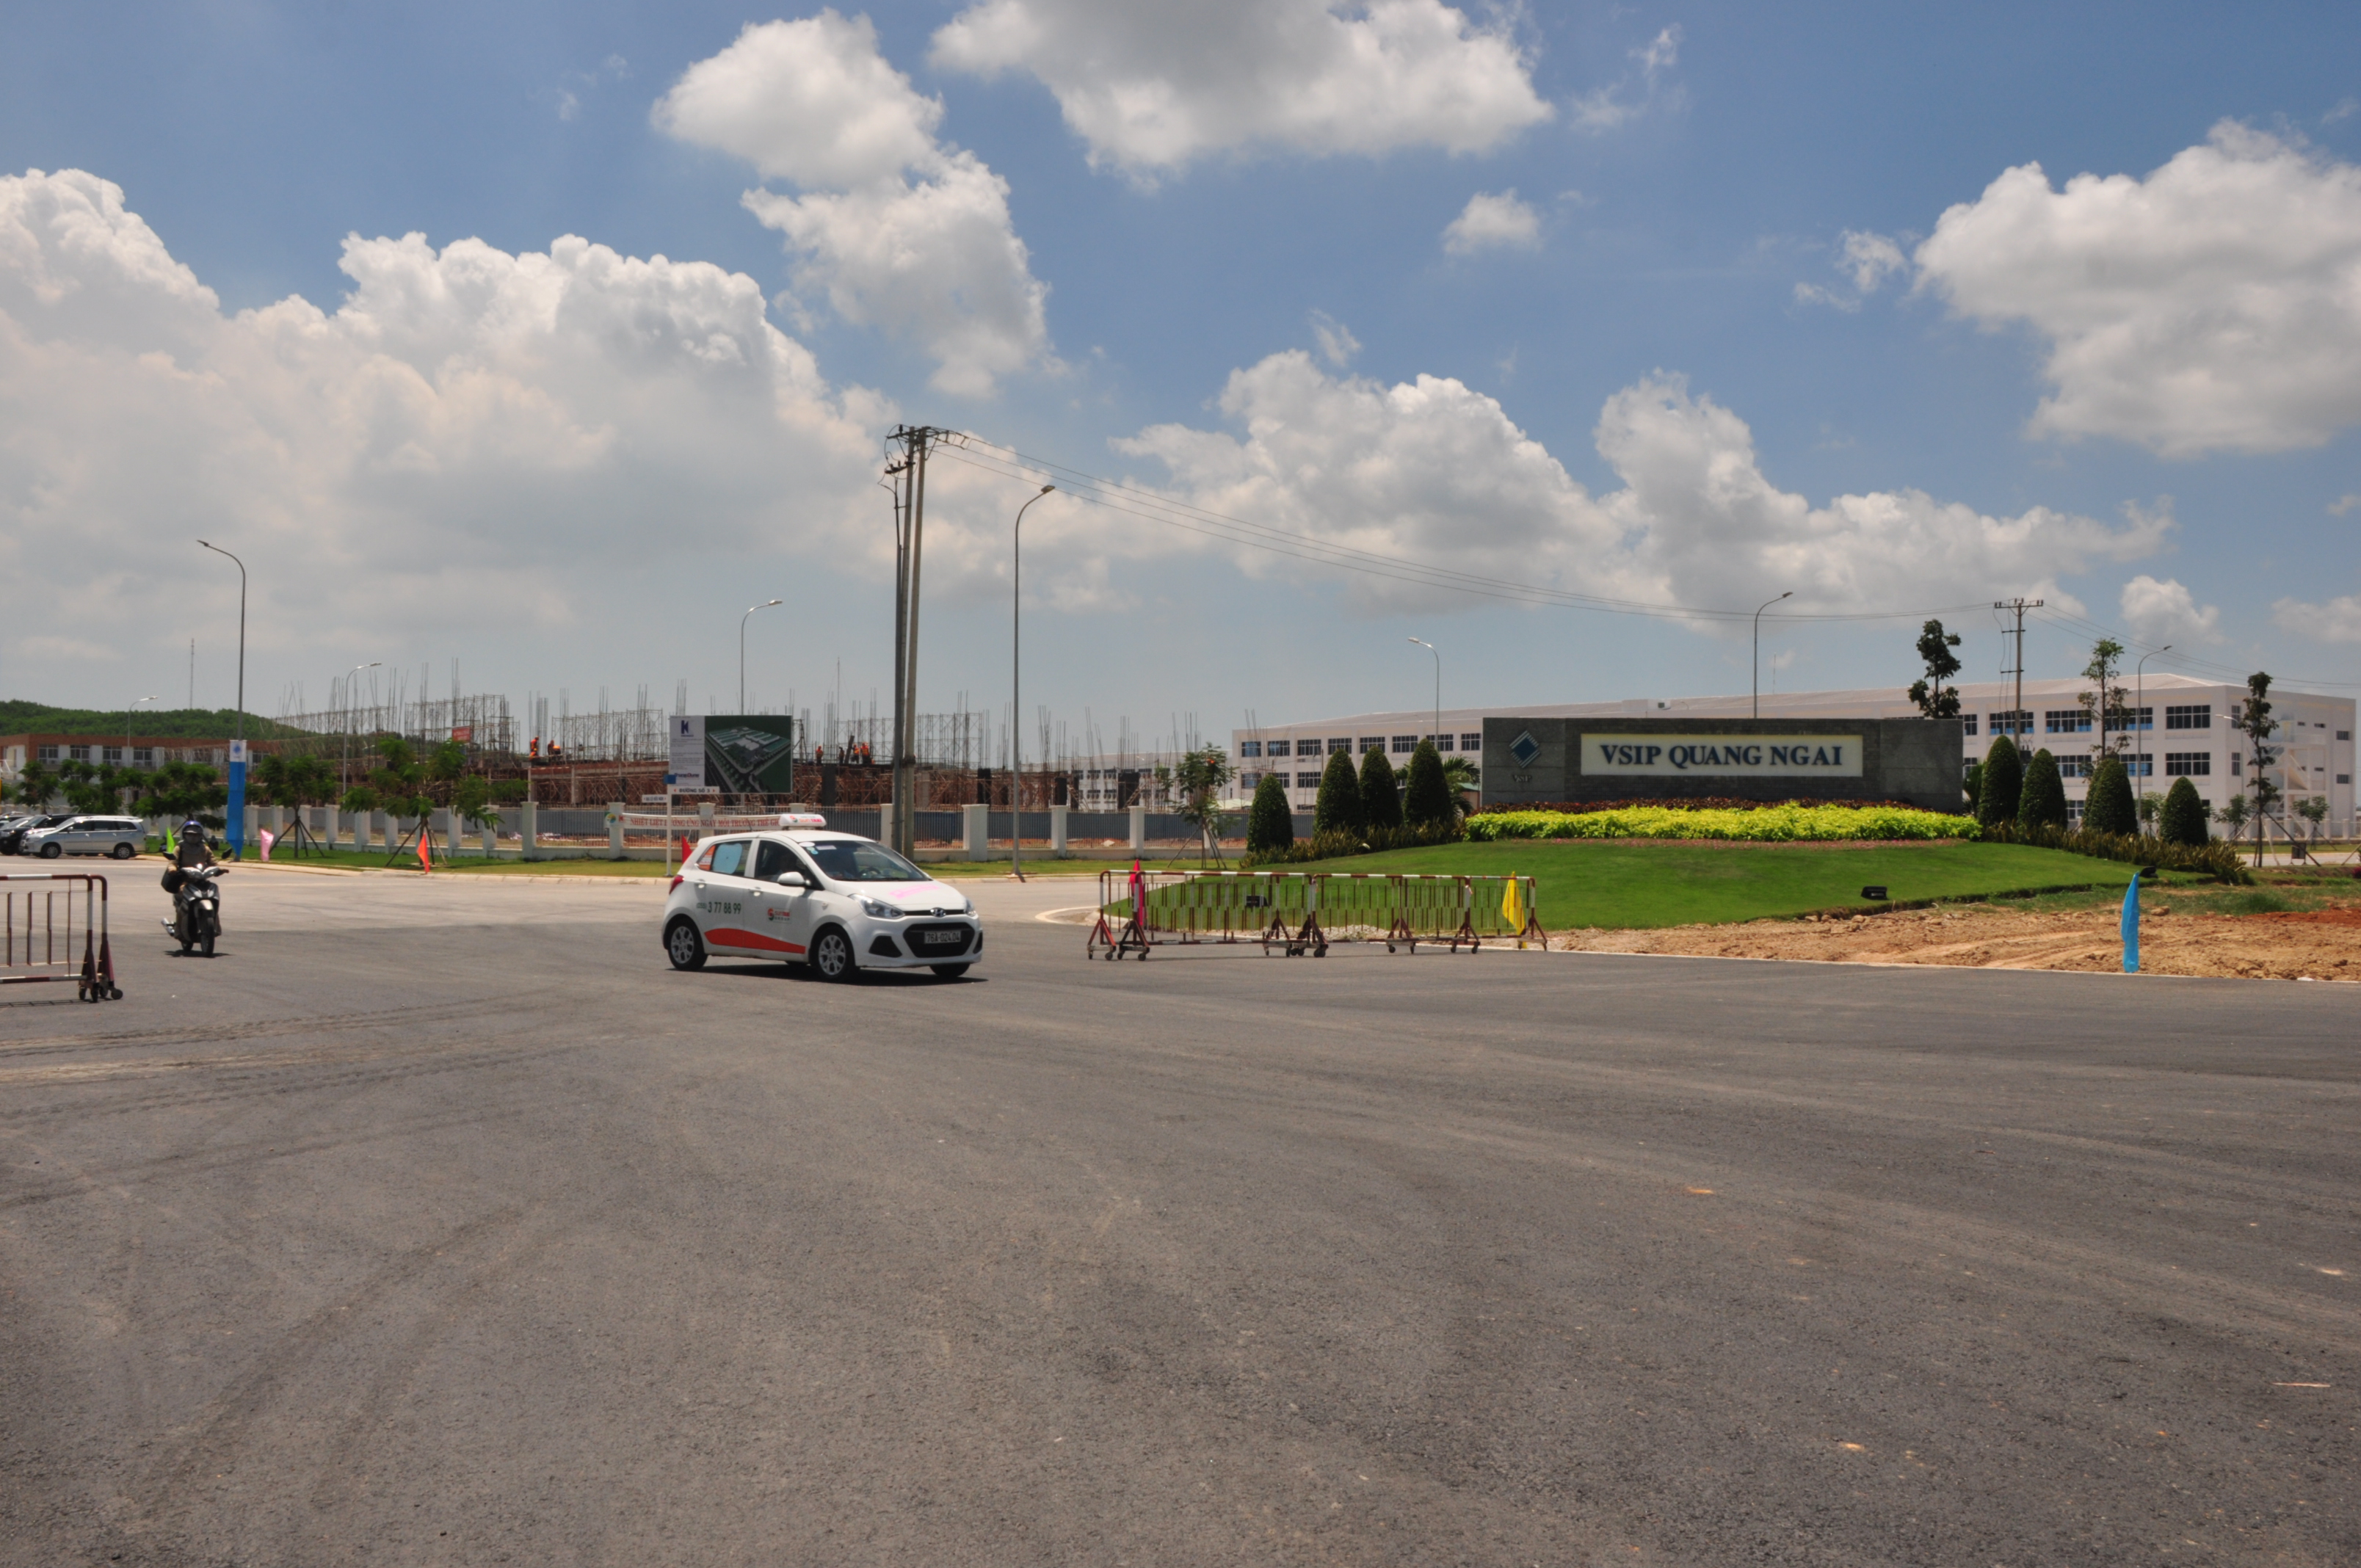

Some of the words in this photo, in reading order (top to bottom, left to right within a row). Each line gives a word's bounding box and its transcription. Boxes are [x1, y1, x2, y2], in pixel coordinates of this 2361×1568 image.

[1600, 744, 1661, 766] VSIP
[1669, 744, 1762, 769] QUANG
[1770, 745, 1843, 766] NGAI
[1512, 774, 1533, 783] VSIP
[714, 901, 722, 914] 77
[723, 902, 732, 915] 88
[733, 903, 741, 915] 99
